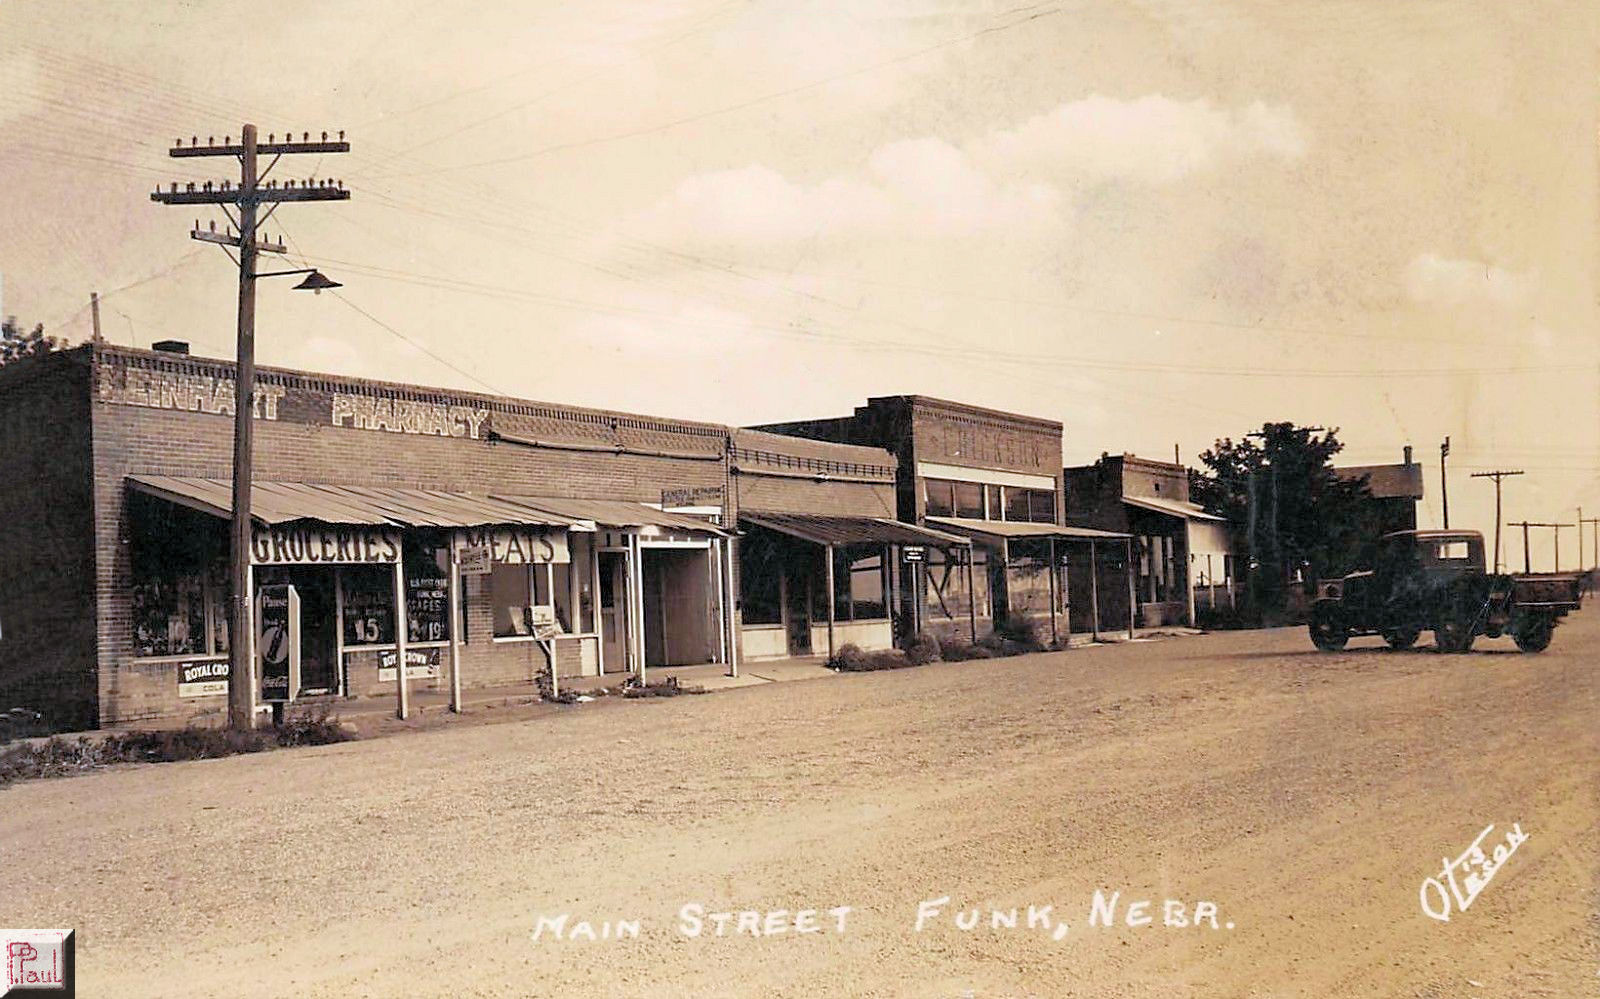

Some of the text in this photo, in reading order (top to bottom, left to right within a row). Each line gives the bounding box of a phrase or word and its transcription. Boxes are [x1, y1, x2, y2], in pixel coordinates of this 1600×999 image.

[332, 391, 489, 440] PHARMACY
[251, 524, 399, 563] GROCERIES
[466, 530, 555, 562] MEATS
[184, 663, 230, 682] ROYAL CRO
[382, 653, 397, 668] ROY
[202, 684, 225, 692] COLA
